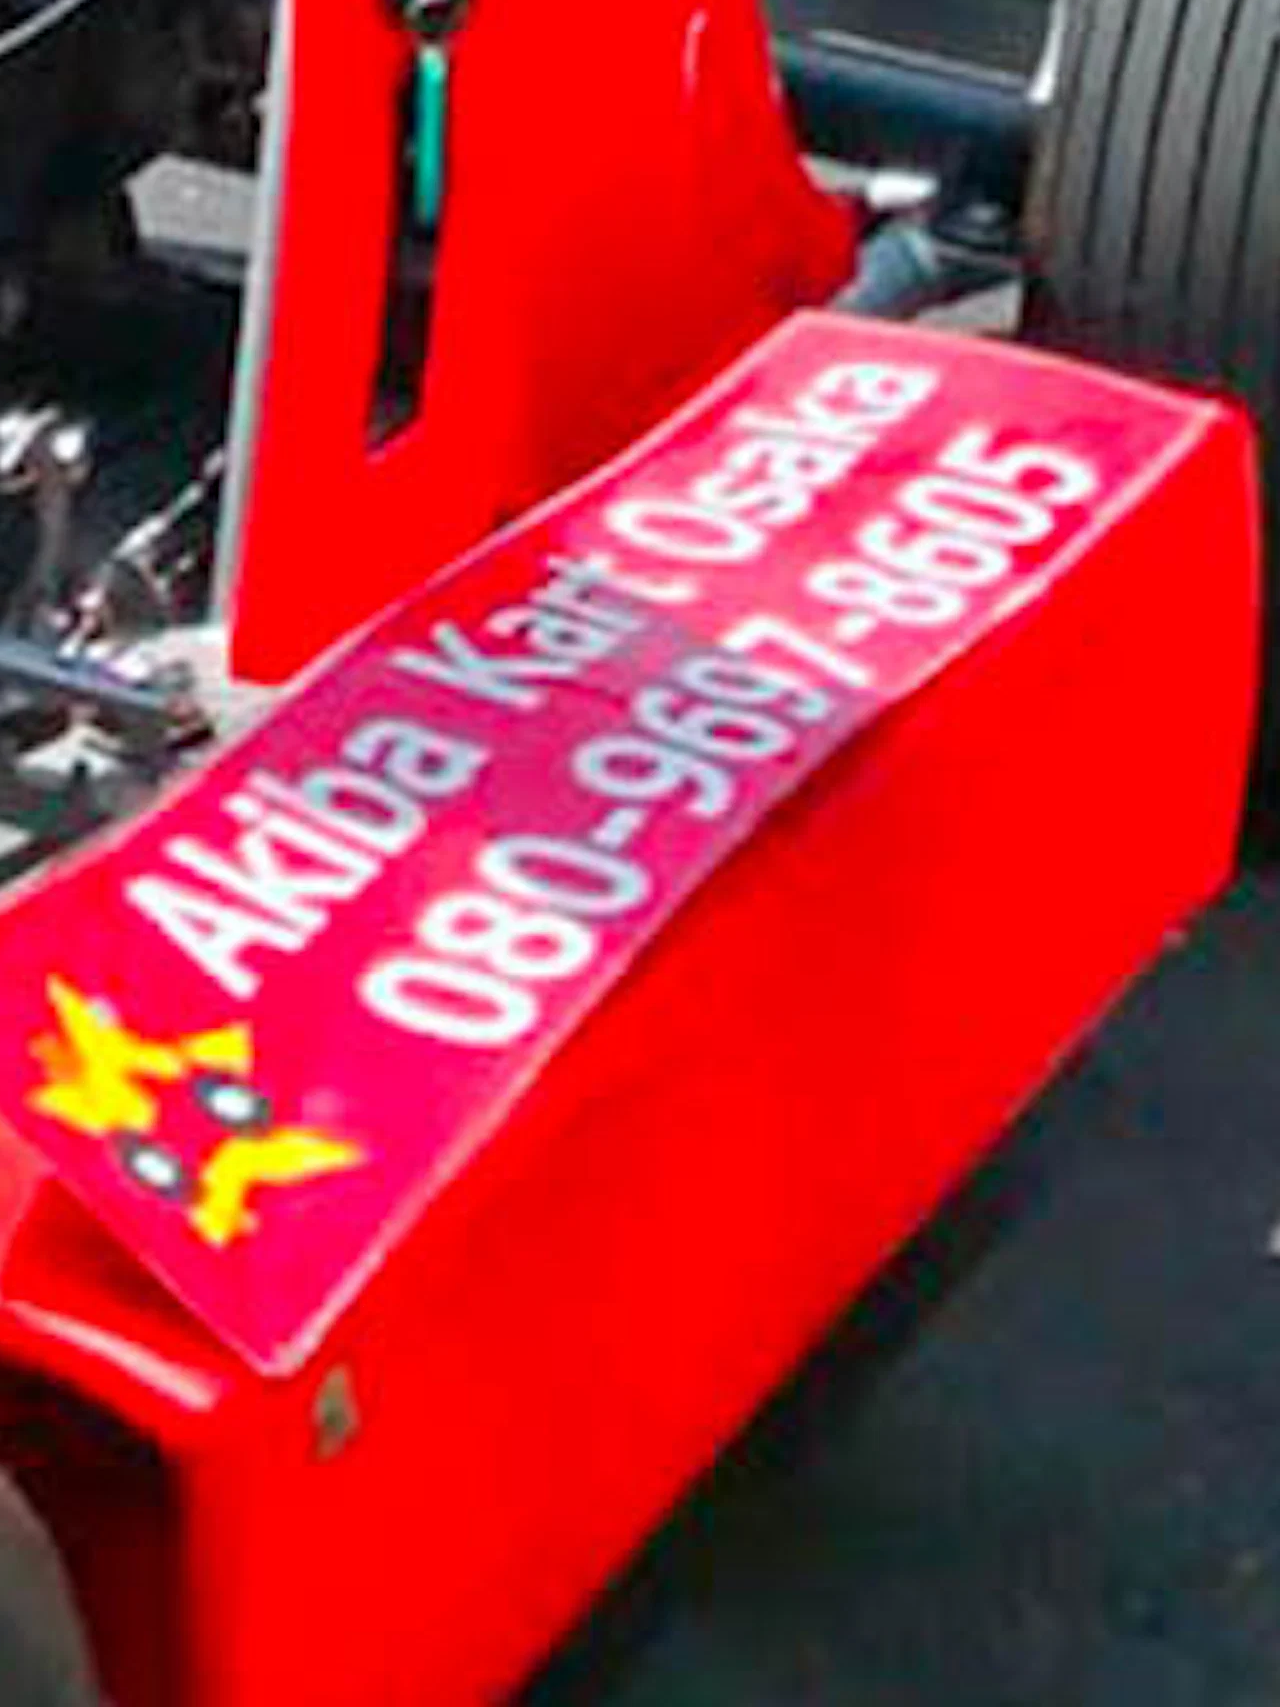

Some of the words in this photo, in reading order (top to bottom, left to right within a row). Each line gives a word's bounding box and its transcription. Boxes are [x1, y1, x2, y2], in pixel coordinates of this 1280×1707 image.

[123, 715, 492, 998] Akiba
[388, 549, 702, 710] Kart
[603, 360, 940, 564] Osaka
[357, 425, 1099, 1047] 080-9697-8605
